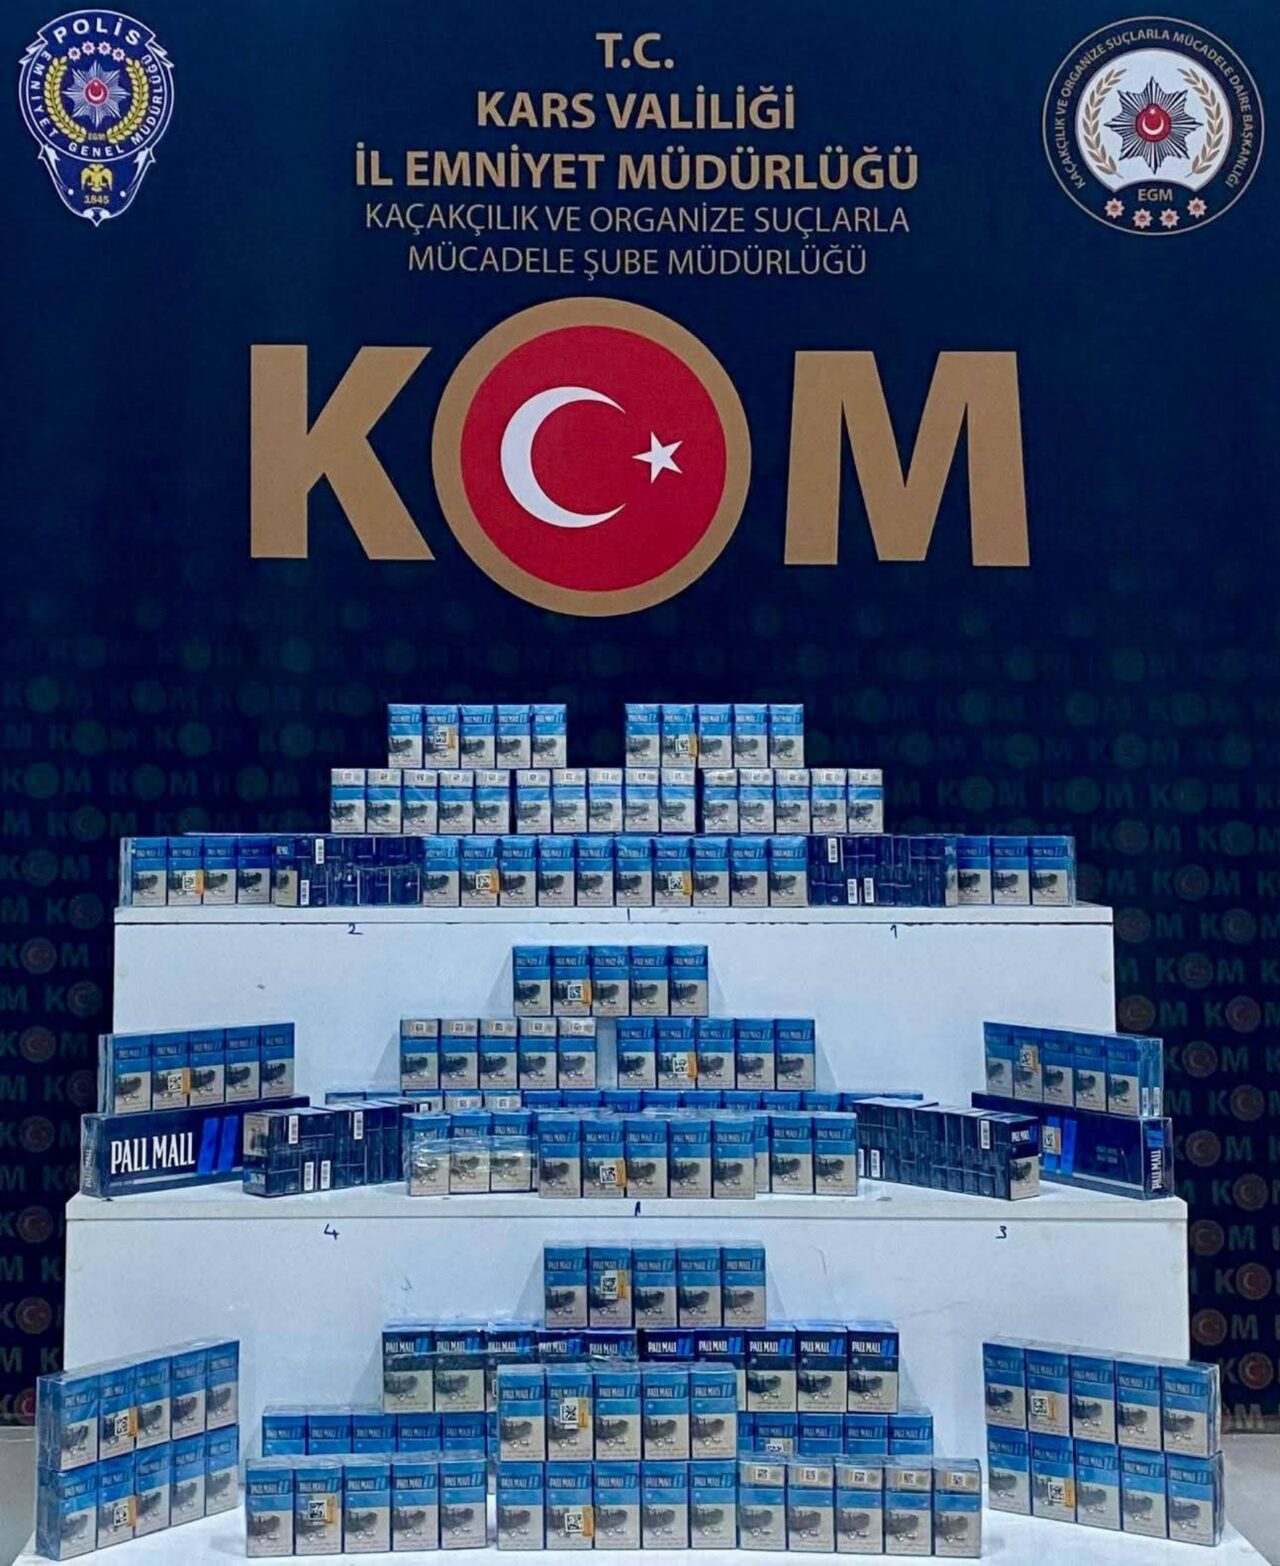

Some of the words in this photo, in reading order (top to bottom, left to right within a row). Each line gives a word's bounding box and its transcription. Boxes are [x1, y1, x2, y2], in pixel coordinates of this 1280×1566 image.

[53, 18, 141, 46] POLİS
[596, 32, 675, 69] T.C.
[477, 90, 596, 129] KARS
[605, 84, 795, 130] VALİLİĞİ
[1055, 98, 1068, 117] VE
[68, 142, 125, 157] GENEL
[356, 141, 394, 187] İL
[406, 143, 606, 190] EMNİYET
[617, 145, 918, 191] MÜDÜRLÜĞÜ
[1137, 188, 1173, 202] EGM
[366, 203, 539, 237] KAÇAKÇILIK
[545, 205, 581, 232] VE
[590, 202, 745, 233] ORGANİZE
[754, 206, 910, 240] SUÇLARLA
[408, 241, 575, 274] MÜCADELE
[583, 248, 659, 281] ŞUBE
[668, 244, 867, 275] MÜDÜRLÜĞÜ
[347, 922, 364, 935] 2
[110, 1136, 150, 1175] PALL
[152, 1132, 196, 1170] MALL
[322, 1223, 341, 1241] 4
